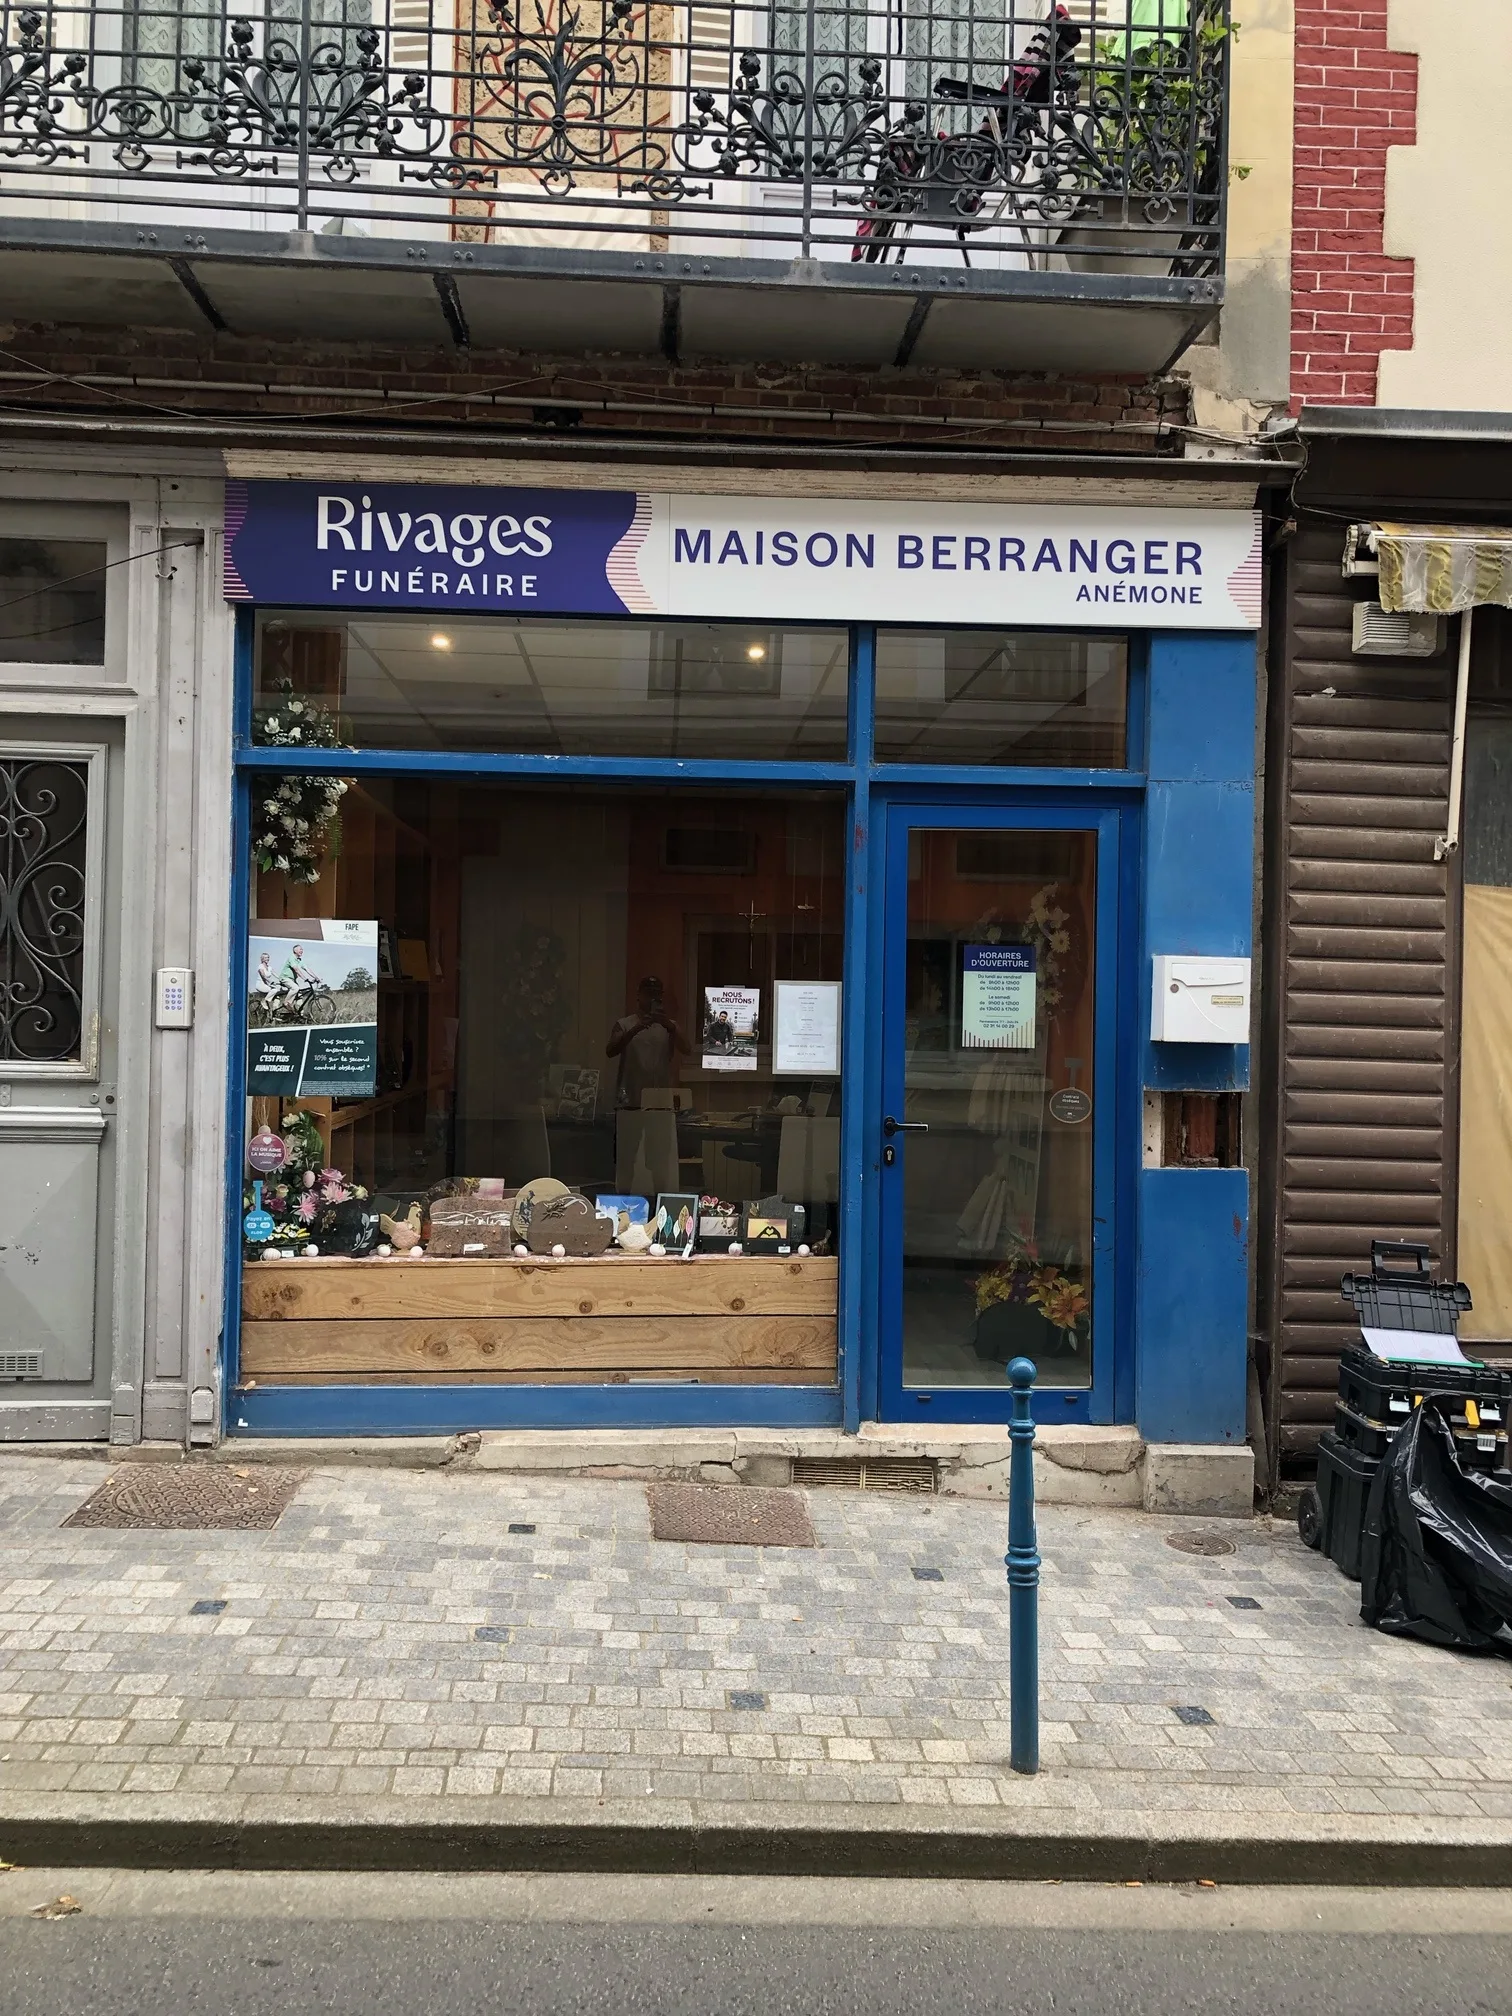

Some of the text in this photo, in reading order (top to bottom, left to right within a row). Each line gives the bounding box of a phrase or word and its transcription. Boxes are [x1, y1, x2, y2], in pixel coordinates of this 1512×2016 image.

[316, 494, 553, 568] Rivages
[673, 528, 1203, 575] MAISON BERRANGER
[331, 566, 538, 597] FUNÉRAIRE
[1075, 581, 1203, 604] ANÉMONE
[345, 923, 359, 931] FAPE
[971, 960, 1030, 968] D'OUVERTURE
[979, 952, 1022, 960] HORAIRES
